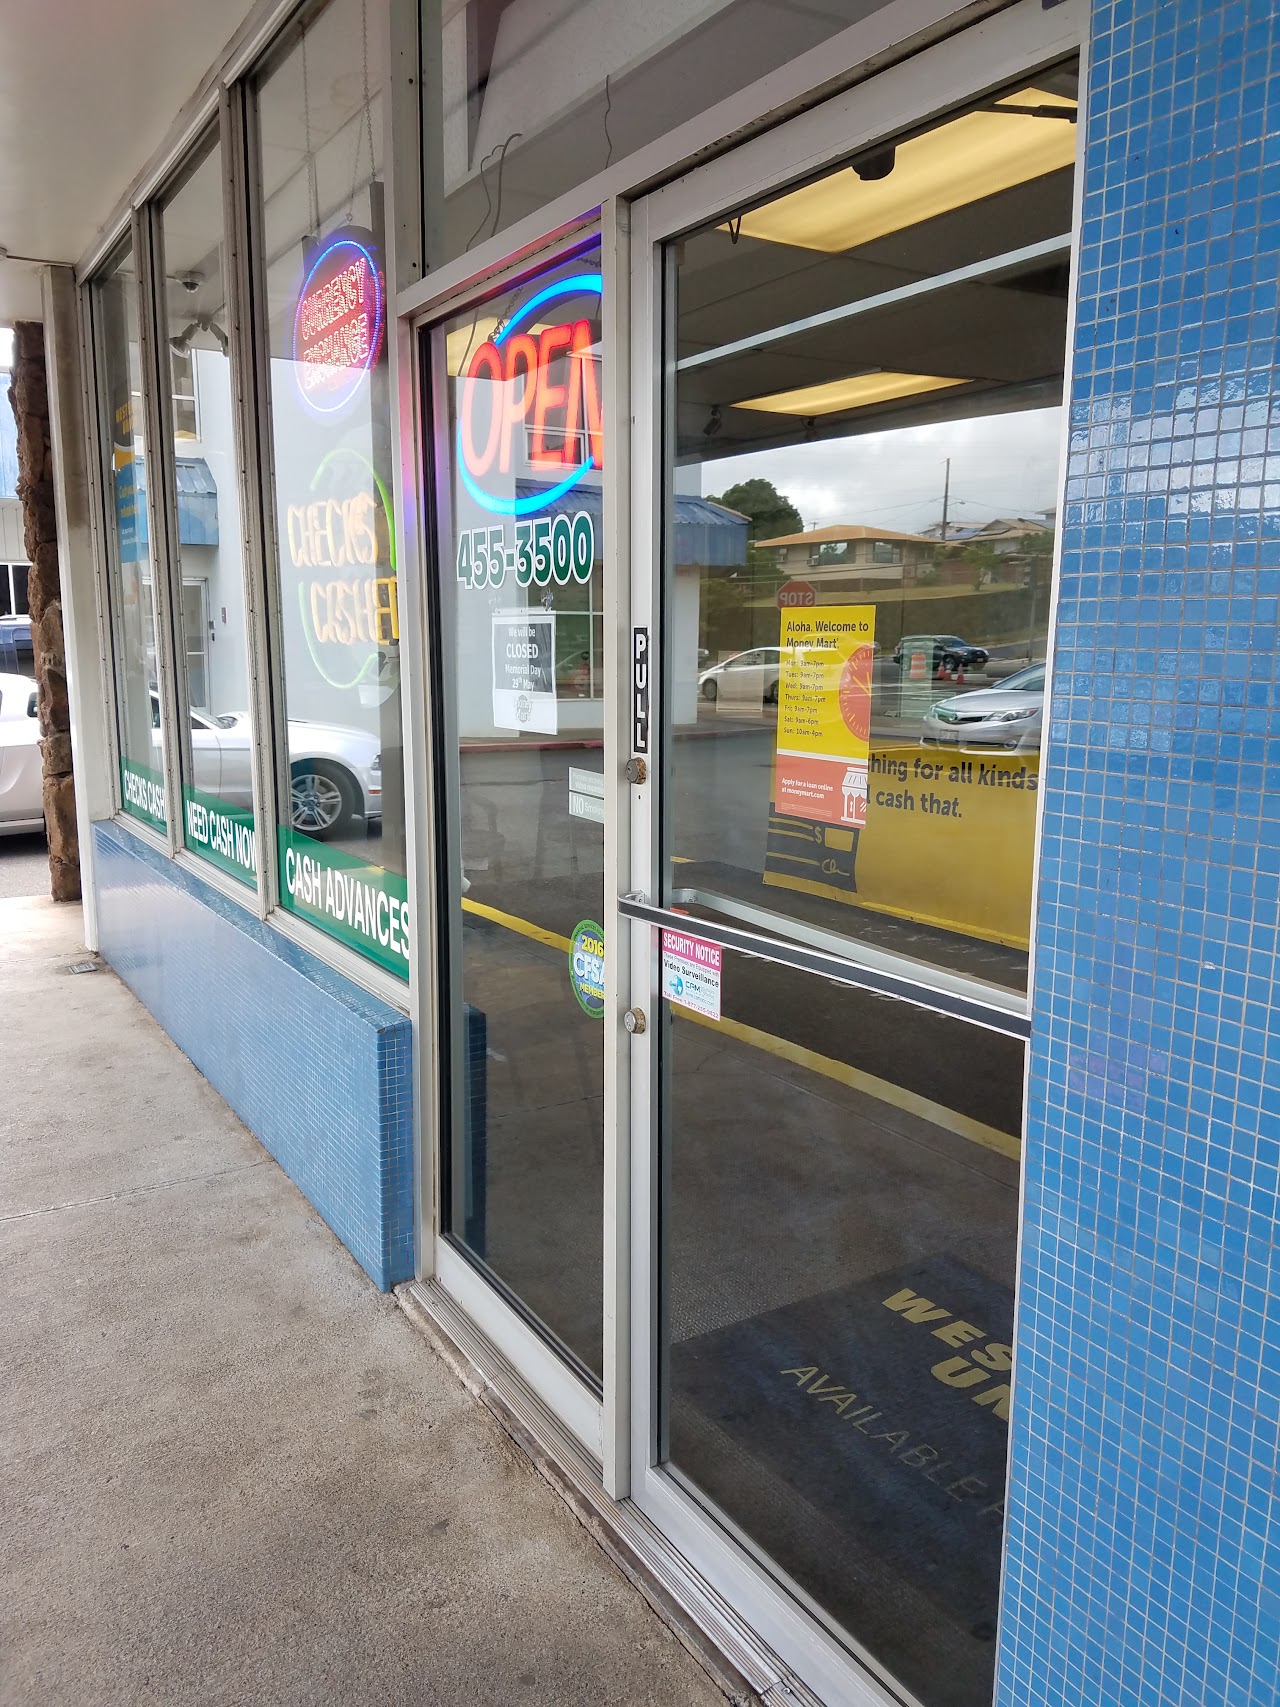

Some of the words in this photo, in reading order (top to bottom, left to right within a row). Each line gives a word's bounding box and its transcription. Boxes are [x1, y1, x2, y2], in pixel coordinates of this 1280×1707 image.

[461, 318, 603, 477] OPEN
[456, 510, 595, 590] 455-3500
[508, 626, 517, 637] We
[517, 626, 528, 637] will
[528, 626, 536, 637] be
[786, 620, 813, 633] Aloha.
[815, 620, 856, 632] Welcome
[859, 620, 869, 632] to
[506, 643, 539, 659] CLOSED
[786, 637, 815, 651] Money
[505, 663, 530, 675] Memorial
[530, 665, 541, 677] Day
[800, 660, 825, 668] 9am-7pm
[785, 670, 799, 678] Tues:
[800, 671, 825, 680] 9am-7pm
[523, 679, 535, 692] May
[634, 633, 648, 748] PULL
[799, 683, 823, 691] 9am-7pm
[785, 693, 800, 701] Thurs:
[802, 694, 826, 703] 9am-7pm
[784, 704, 793, 712] Fri:
[794, 705, 817, 714] 9am-7pm
[784, 715, 794, 723] Sat:
[795, 716, 819, 726] 9am-6pm
[783, 726, 795, 734] Sun:
[796, 728, 823, 738] 10am-4pm
[914, 758, 944, 780] for
[948, 761, 973, 784] all
[977, 763, 1039, 791] kinds
[124, 769, 148, 811] CHECKS
[781, 777, 795, 787] Apply
[806, 781, 818, 789] loan
[817, 784, 834, 792] online
[786, 787, 825, 799] moneymart.com
[572, 795, 584, 815] NO
[875, 789, 915, 811] cash
[920, 793, 963, 818] that.
[186, 799, 209, 845] NEED
[209, 809, 235, 860] CASH
[285, 847, 323, 910] CASH
[324, 866, 410, 960] ADVANCES
[581, 934, 604, 957] 2016
[663, 931, 695, 957] SECURITY
[695, 942, 720, 967] NOTICE
[663, 959, 681, 973] Video
[681, 966, 720, 988] Surveillance
[780, 1366, 989, 1502] AVAILABLE
